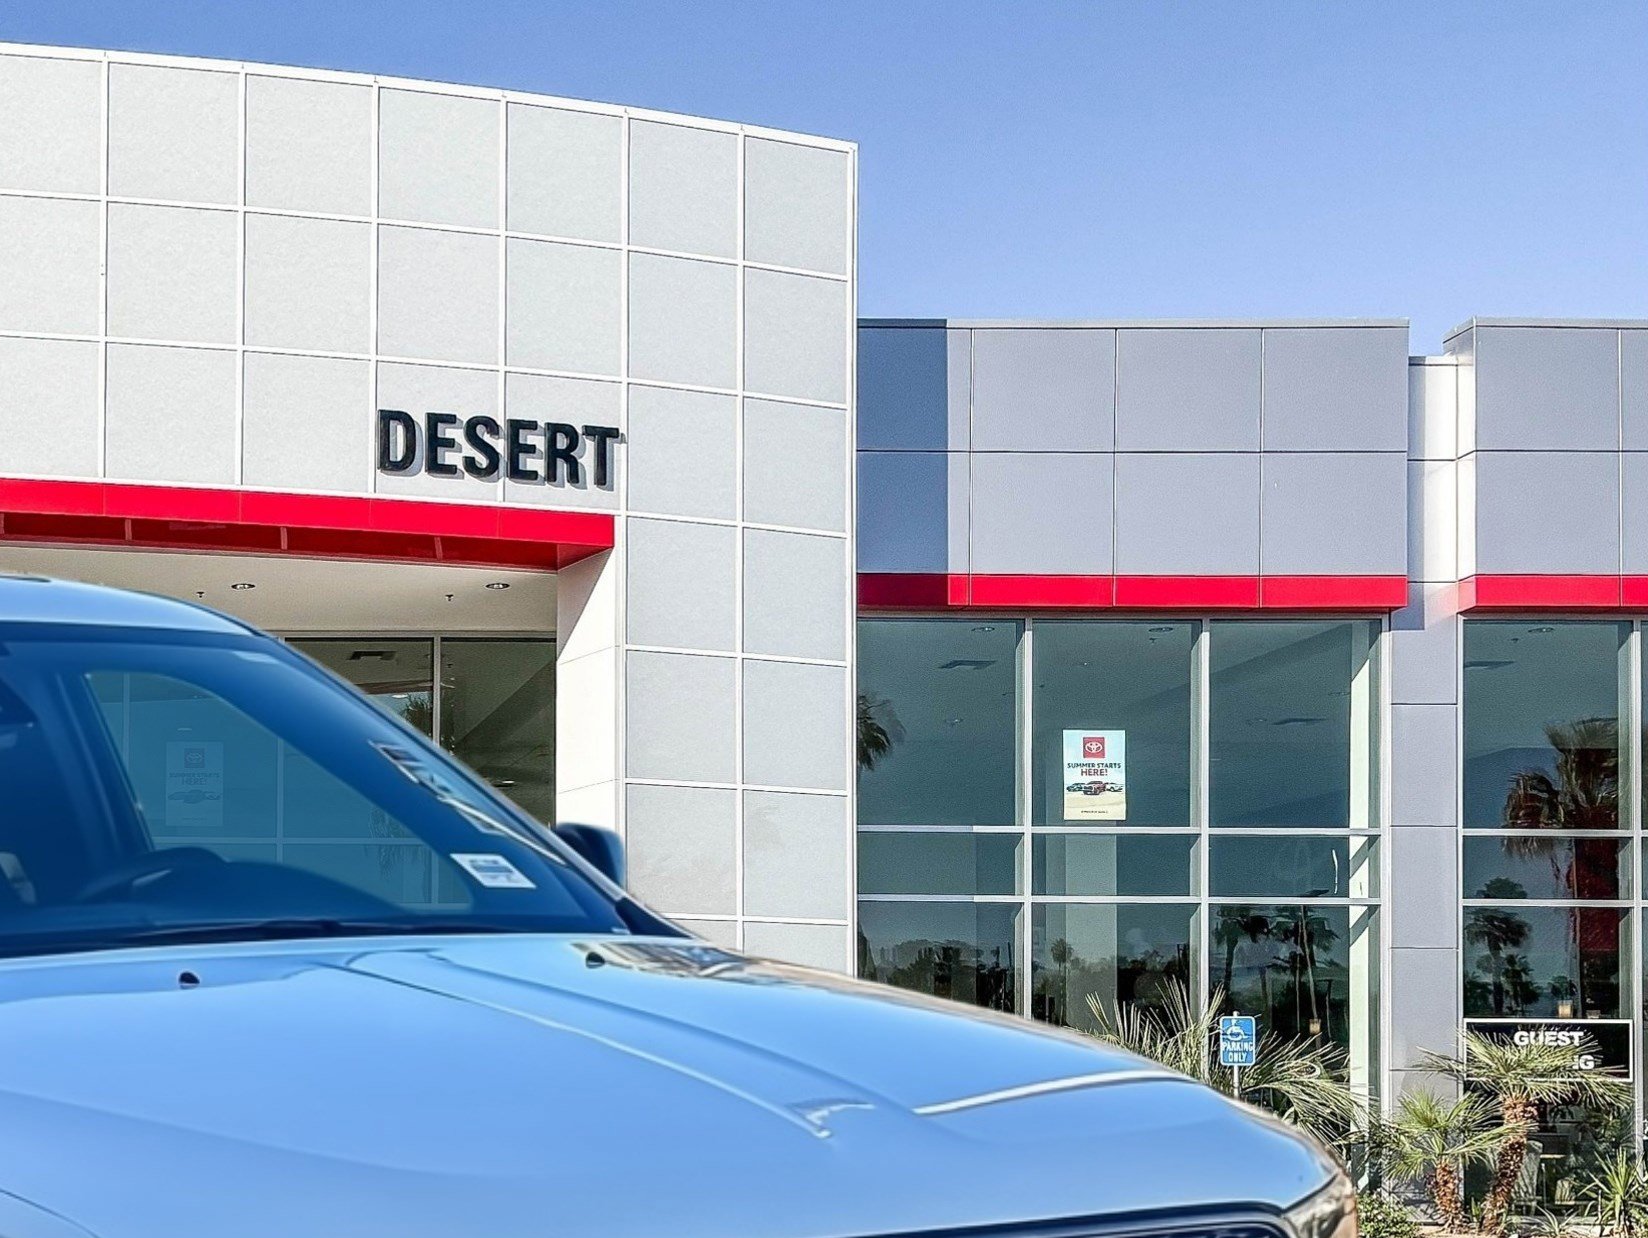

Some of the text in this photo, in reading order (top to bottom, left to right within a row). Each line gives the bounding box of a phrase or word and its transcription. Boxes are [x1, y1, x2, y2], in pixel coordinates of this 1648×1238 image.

[377, 409, 620, 486] DESERT
[1514, 1031, 1584, 1046] GUEST
[1222, 1041, 1254, 1052] PARKING
[1228, 1051, 1247, 1063] ONLY
